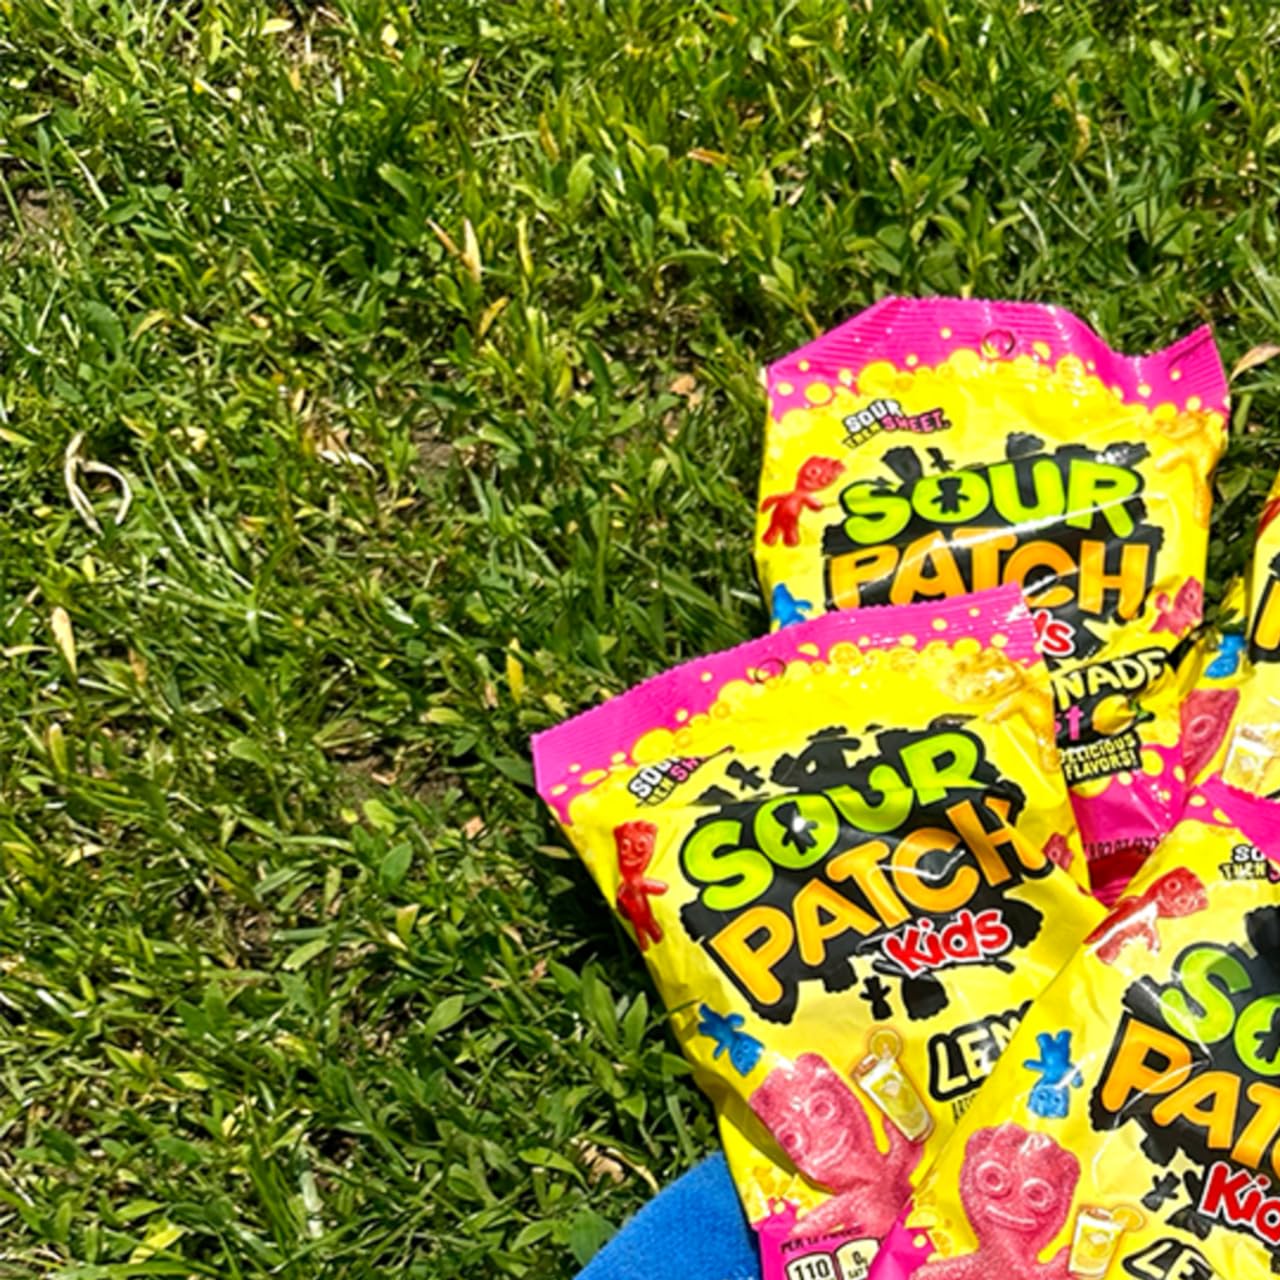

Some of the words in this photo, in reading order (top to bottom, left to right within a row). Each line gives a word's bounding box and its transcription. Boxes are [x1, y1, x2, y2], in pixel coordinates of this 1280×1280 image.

[844, 399, 903, 433] SOUR
[842, 460, 1139, 543] SOUR
[828, 528, 1150, 620] PATCH
[1051, 650, 1166, 711] NADE
[686, 734, 986, 909] SOUR
[714, 799, 1048, 1005] PATCH
[885, 910, 1010, 976] Kids
